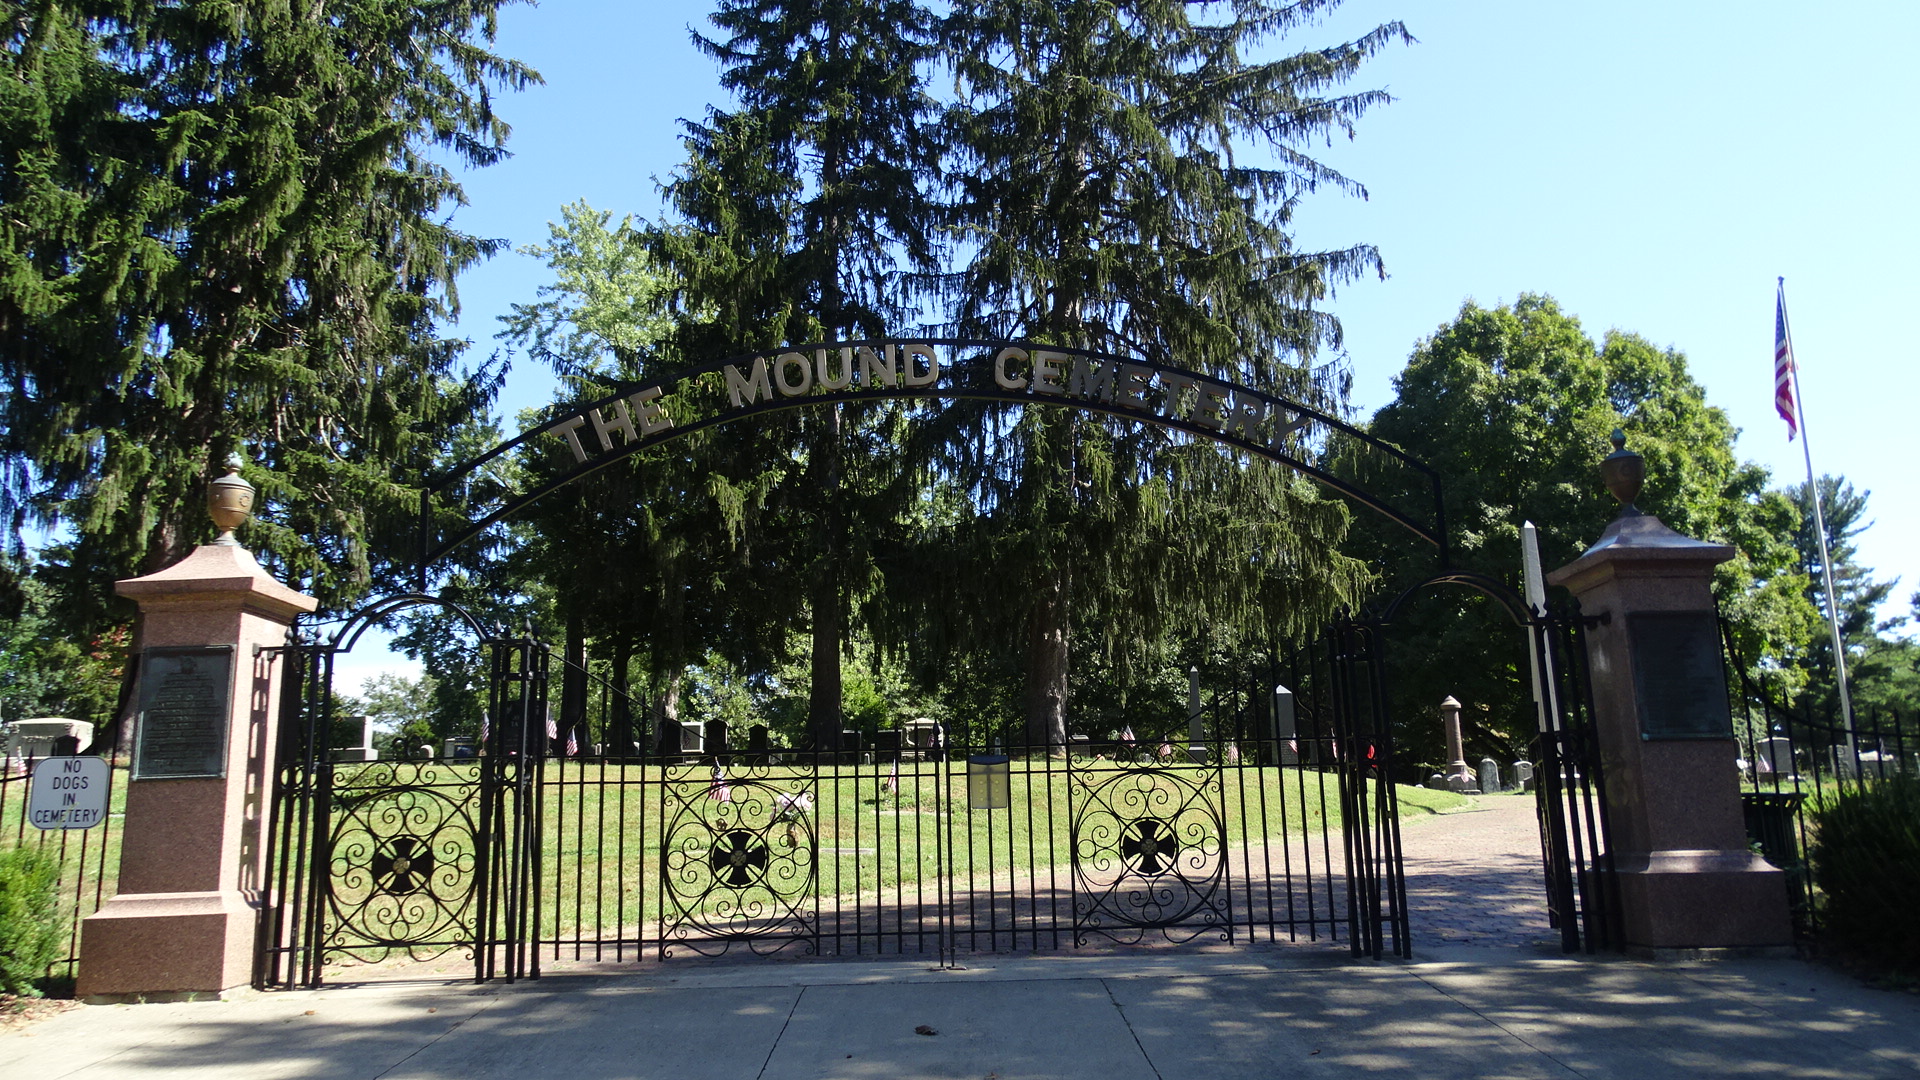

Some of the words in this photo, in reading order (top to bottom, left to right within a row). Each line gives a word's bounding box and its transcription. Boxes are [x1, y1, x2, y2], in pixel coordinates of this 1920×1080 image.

[550, 385, 674, 463] THE
[723, 343, 939, 408] MOUND
[994, 346, 1312, 451] CEMETERY
[63, 760, 82, 773] NO
[52, 776, 89, 790] DOGS
[62, 793, 76, 806] IN
[35, 808, 99, 823] CEMETERY
